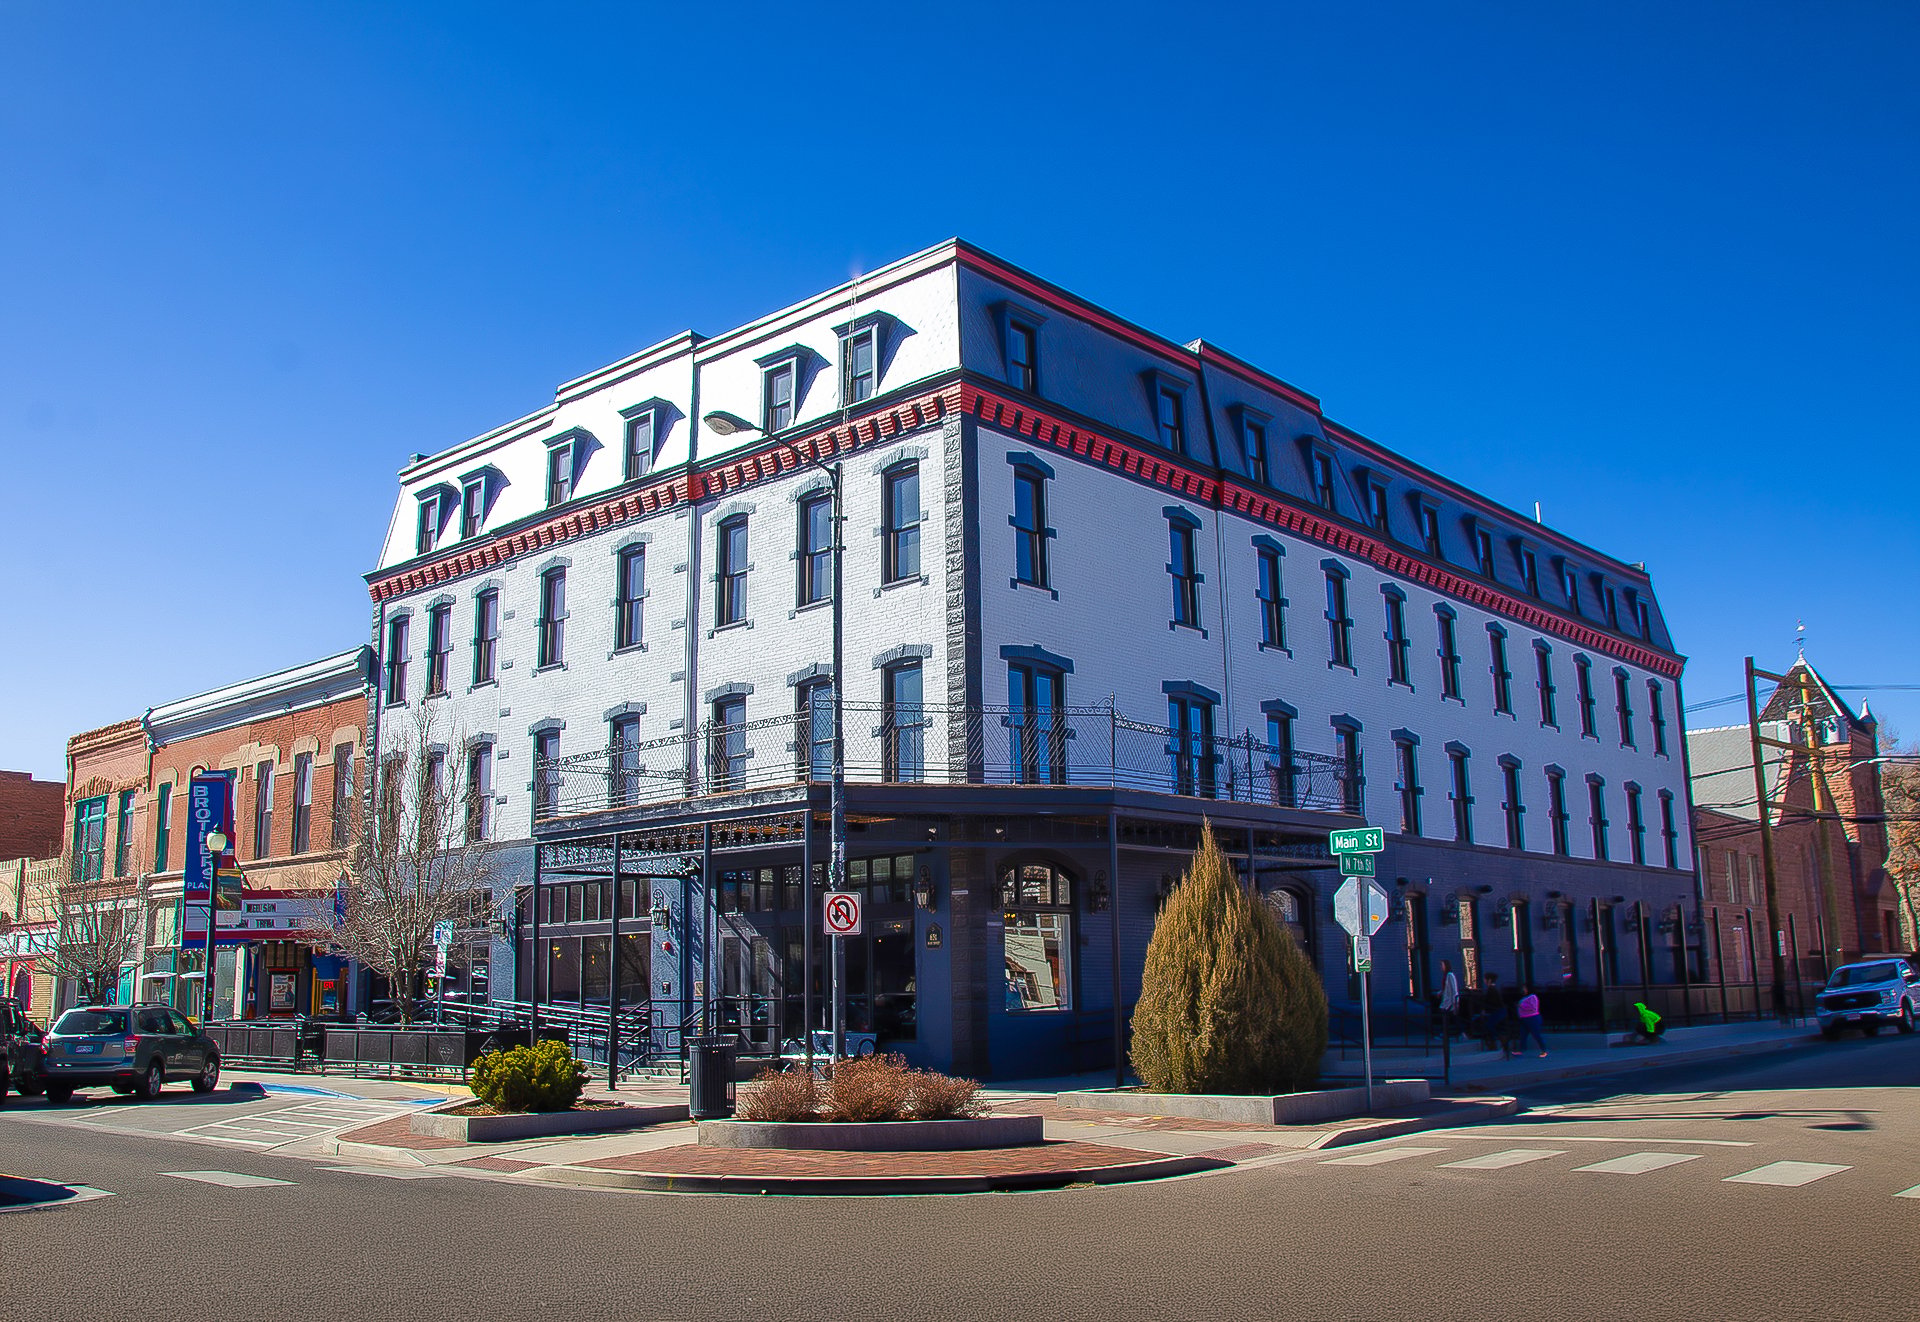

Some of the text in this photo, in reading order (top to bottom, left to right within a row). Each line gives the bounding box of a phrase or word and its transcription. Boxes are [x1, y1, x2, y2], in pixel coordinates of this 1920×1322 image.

[1335, 833, 1378, 849] Main St
[1345, 857, 1373, 872] N 7th St
[187, 882, 210, 890] PLA
